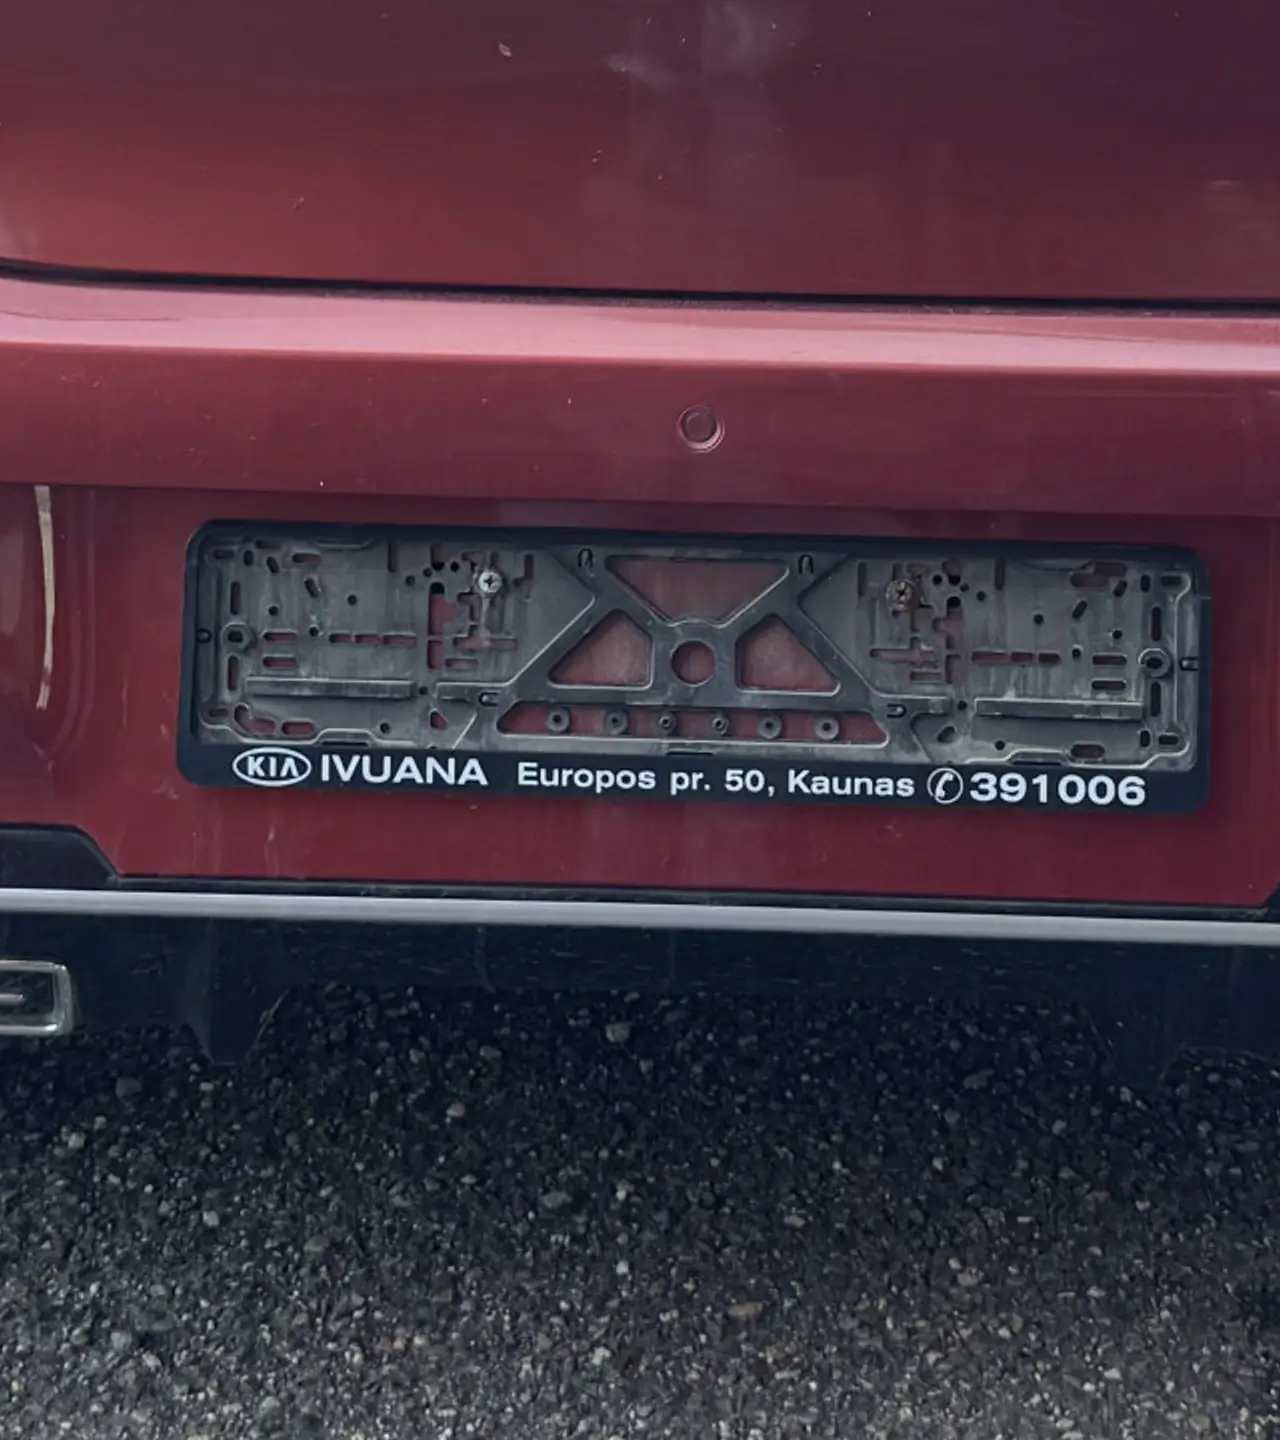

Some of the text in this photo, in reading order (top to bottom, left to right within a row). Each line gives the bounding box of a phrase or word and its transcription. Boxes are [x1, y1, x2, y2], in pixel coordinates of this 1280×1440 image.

[246, 754, 1147, 806] KIA IVUANA Europos pr. 50, Kaunas 391006
